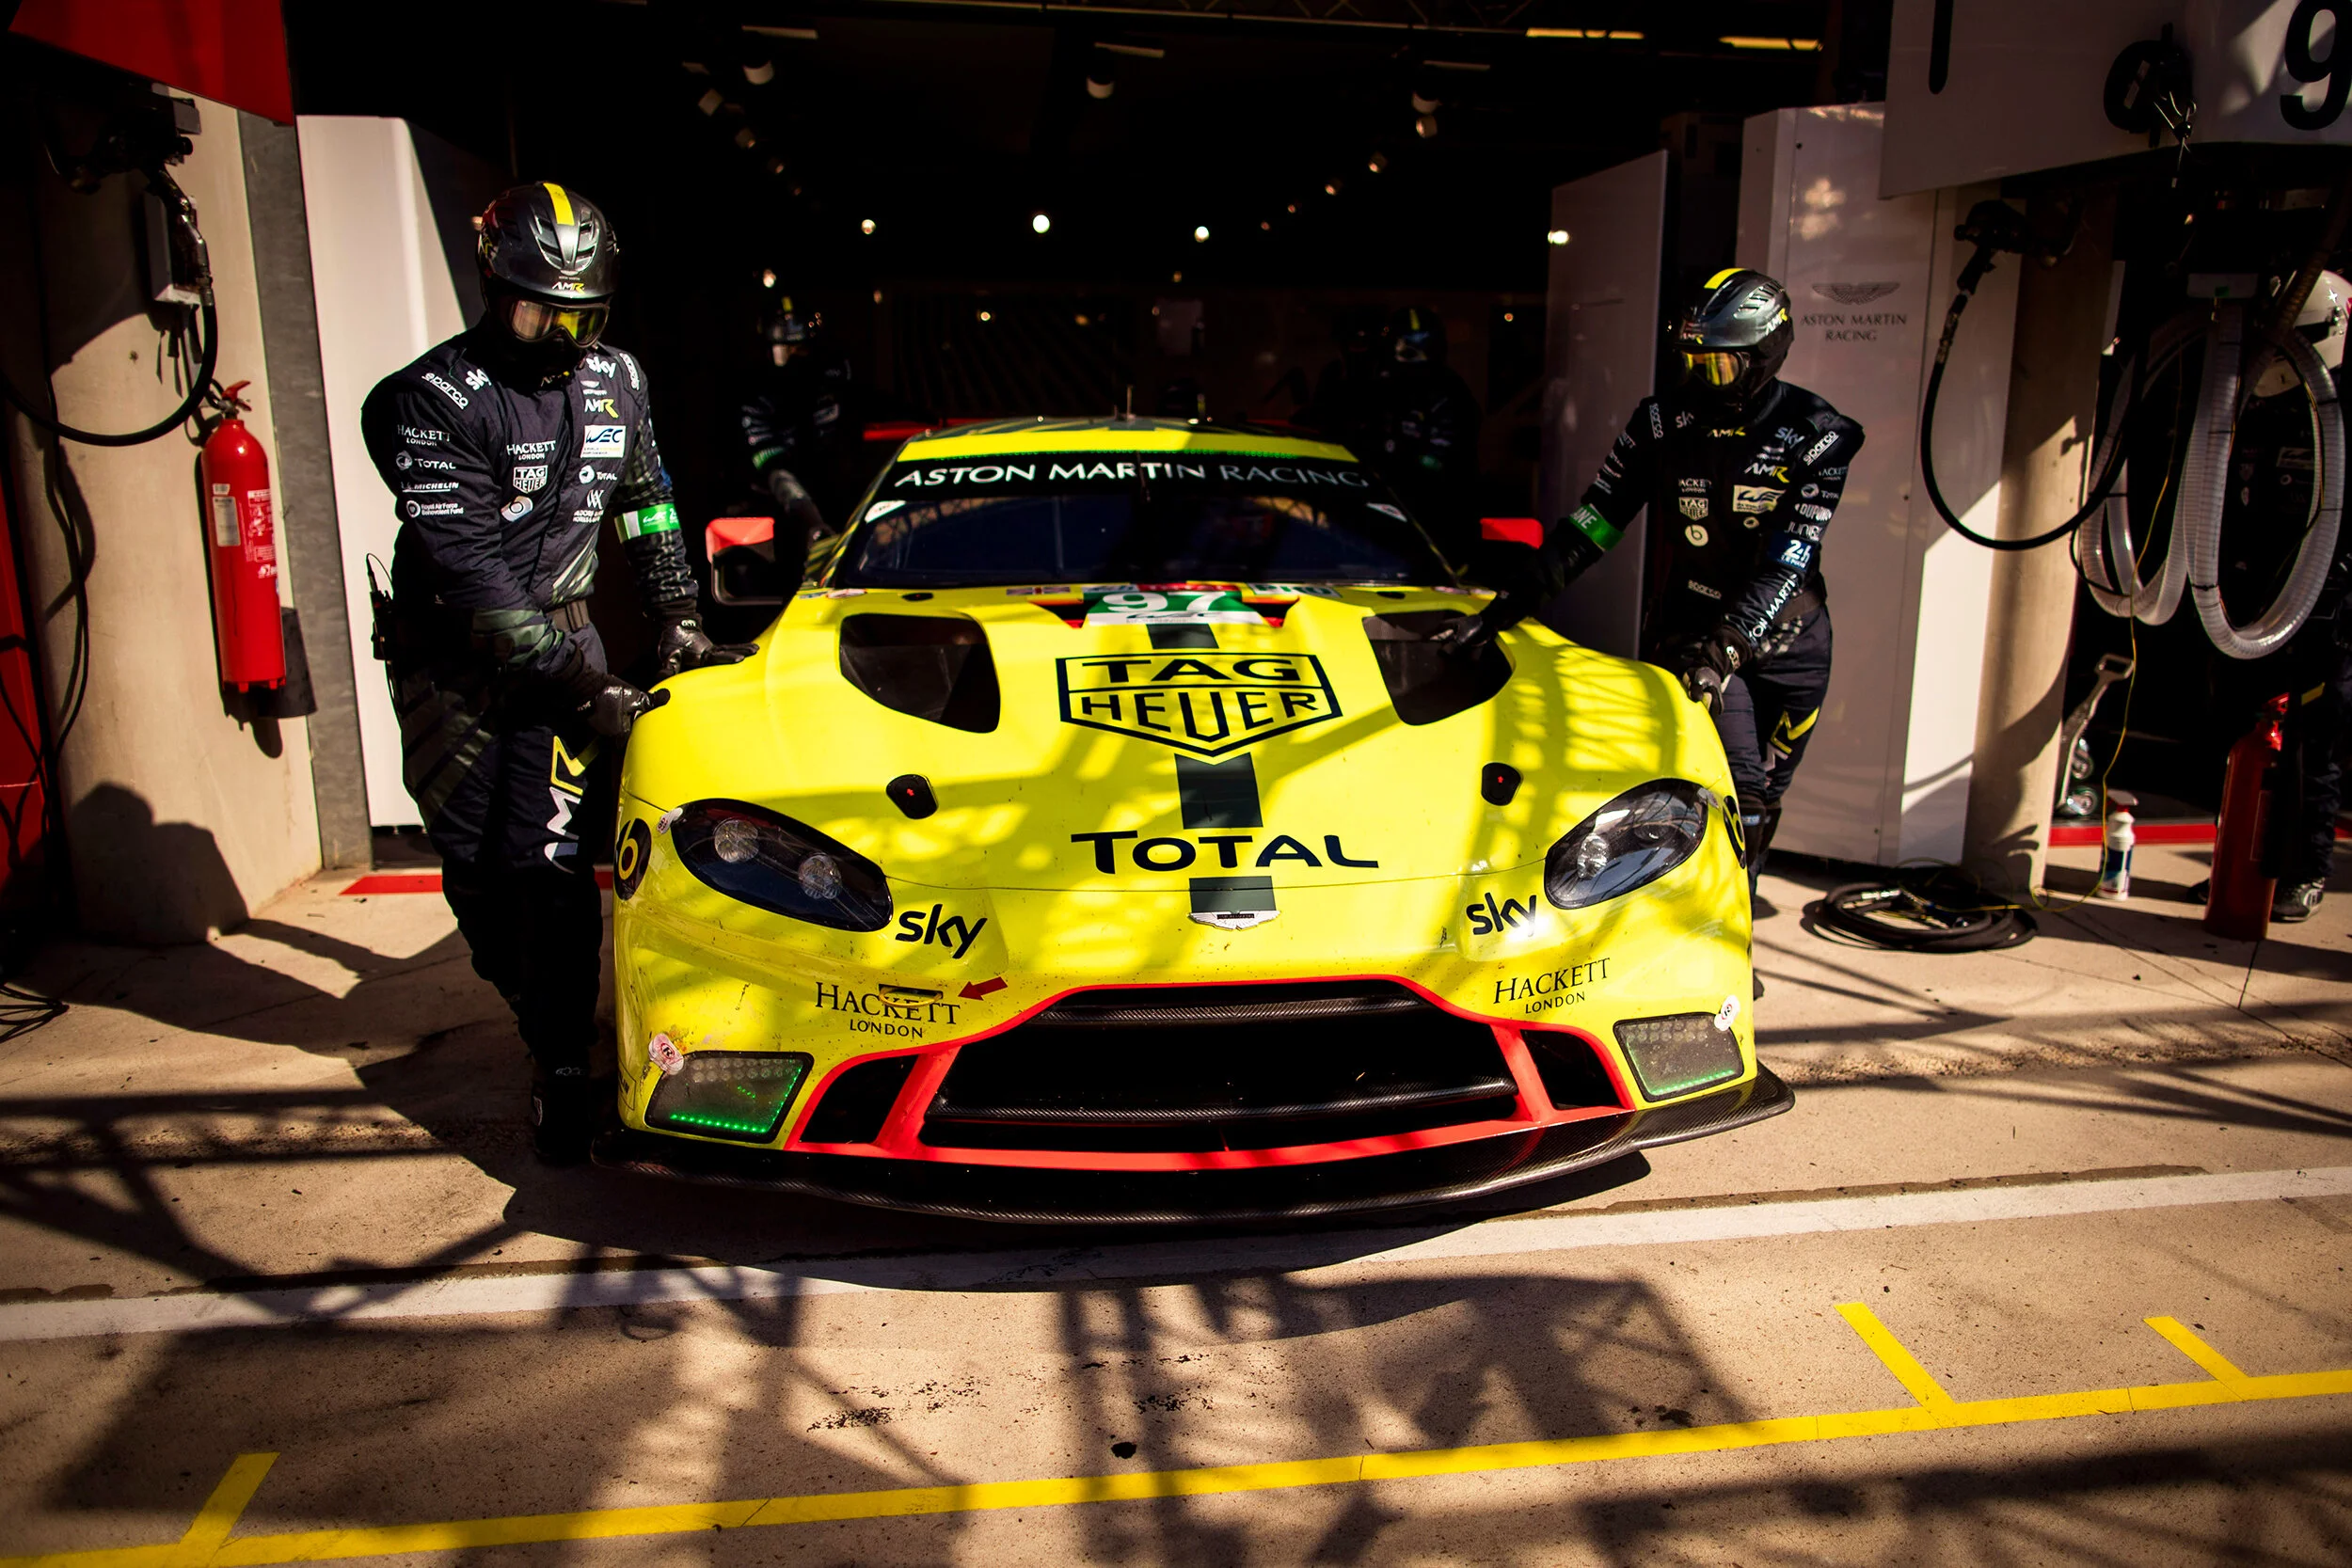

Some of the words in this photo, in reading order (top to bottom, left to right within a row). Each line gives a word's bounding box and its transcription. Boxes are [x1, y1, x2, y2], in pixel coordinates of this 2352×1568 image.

[552, 282, 585, 293] AMR
[1801, 313, 1844, 326] ASTON
[1851, 313, 1908, 326] MARTIN
[1825, 330, 1877, 342] RACING
[421, 372, 469, 410] sparco
[397, 425, 452, 442] HACKETT
[1774, 426, 1805, 449] sky
[506, 440, 556, 456] HACKETT
[518, 452, 546, 461] LONDON
[1803, 430, 1840, 467] sparco
[414, 458, 456, 469] TOTAL
[516, 467, 546, 478] TAG
[894, 463, 1036, 488] ASTON
[1048, 461, 1206, 482] MARTIN
[1220, 464, 1369, 488] RACING
[1744, 462, 1790, 483] AMR
[414, 482, 459, 490] MICHELIN
[1102, 591, 1227, 612] 97
[1082, 658, 1301, 684] TAG
[1081, 690, 1319, 743] HEUER
[1071, 830, 1379, 875] TOTAL
[1465, 892, 1537, 938] sky
[895, 903, 988, 959] sky
[1493, 957, 1611, 1006] HACKETT
[815, 981, 961, 1026] HACKETT
[1524, 990, 1586, 1014] LONDON
[849, 1018, 924, 1039] LONDON
